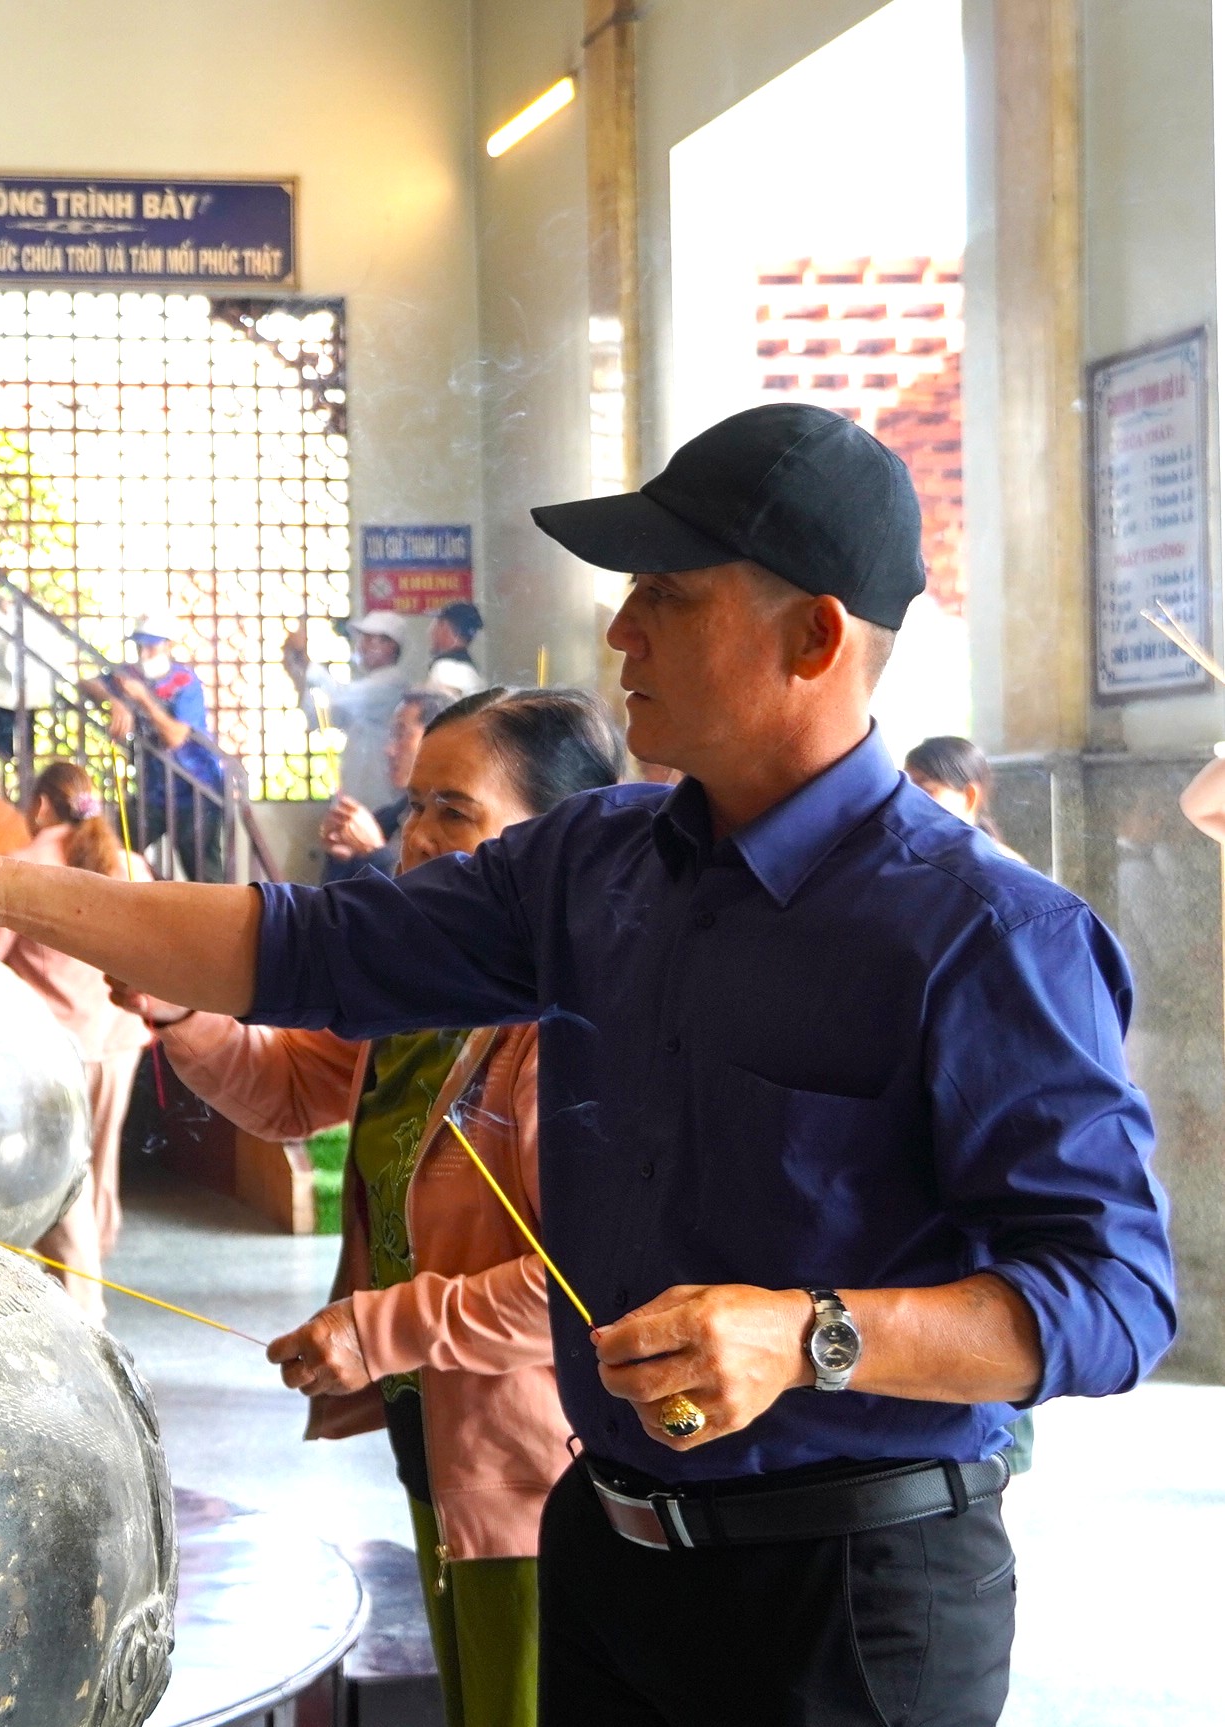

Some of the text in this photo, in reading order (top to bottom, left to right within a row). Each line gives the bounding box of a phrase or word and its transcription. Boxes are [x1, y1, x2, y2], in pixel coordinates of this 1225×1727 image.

[52, 185, 135, 219] TRÌNH
[142, 187, 198, 220] BÀY
[21, 239, 62, 272] CHÚA
[65, 240, 102, 273] TRỜI
[105, 241, 126, 273] VÀ
[129, 240, 163, 274] TÁM
[166, 238, 195, 274] MỐI
[198, 241, 240, 275] PHÚC
[242, 243, 283, 280] THẬT
